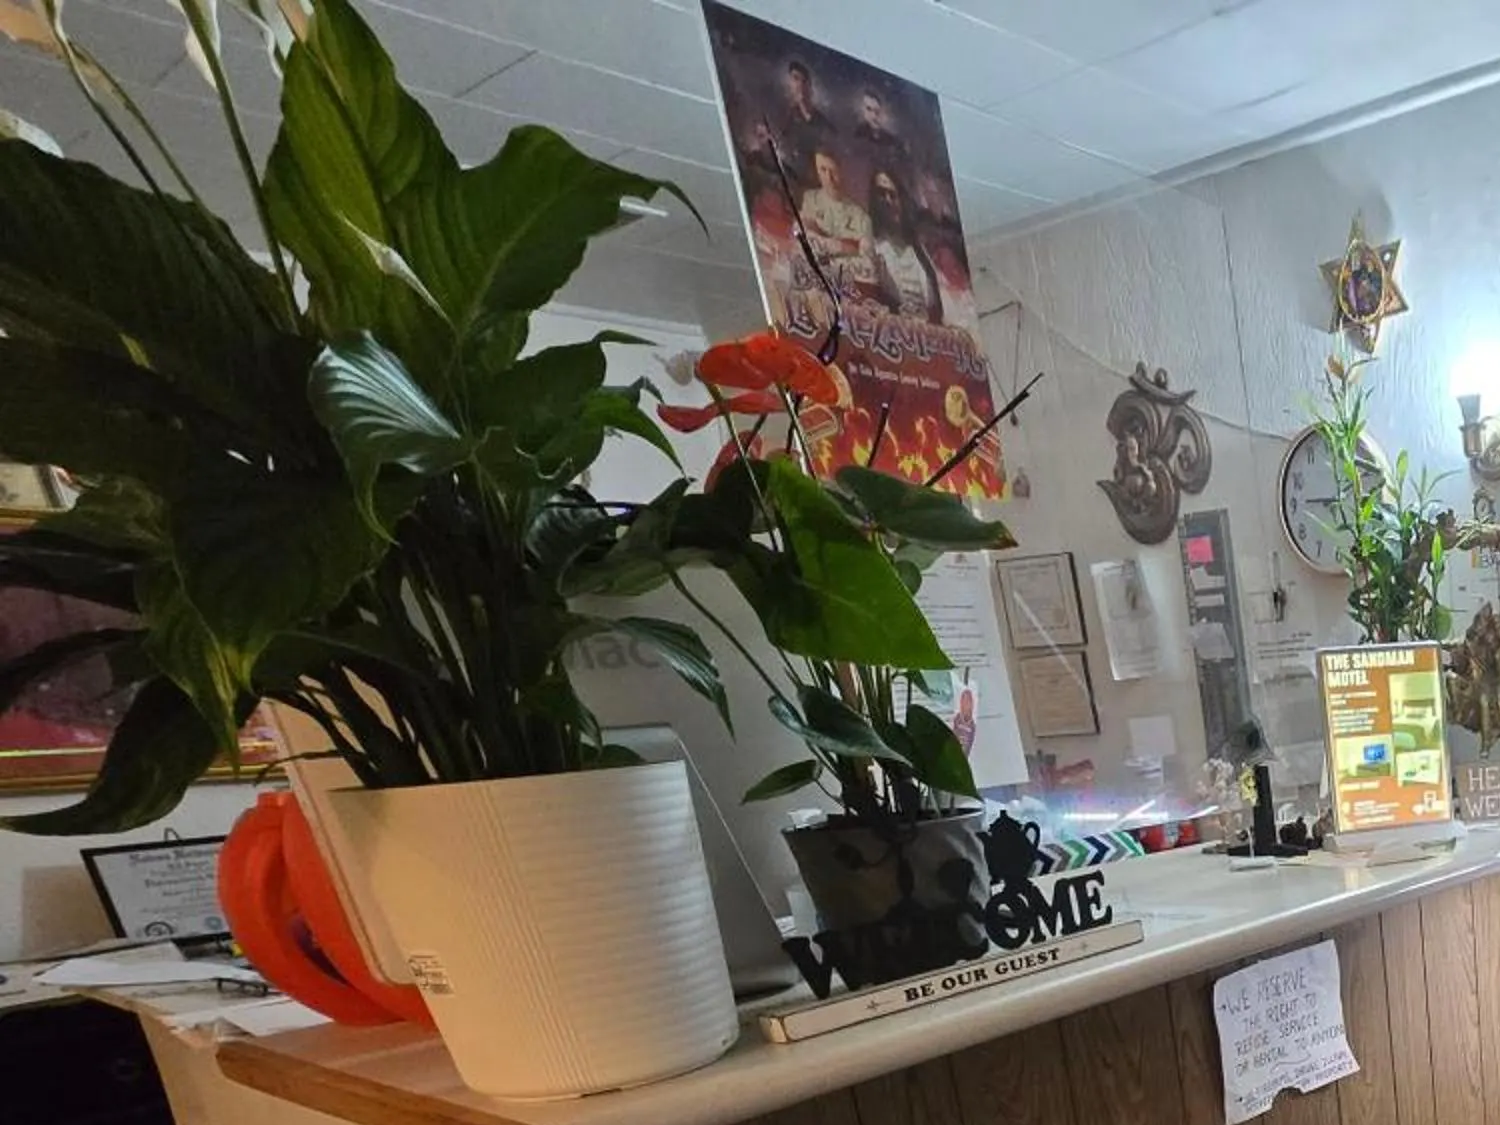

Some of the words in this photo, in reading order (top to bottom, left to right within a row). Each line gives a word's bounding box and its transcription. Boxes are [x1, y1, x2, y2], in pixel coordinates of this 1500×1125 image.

[1325, 653, 1350, 671] THE
[1351, 648, 1415, 670] SANDMAN
[1326, 669, 1371, 689] MOTEL
[780, 870, 1114, 1002] WCOME
[904, 981, 936, 1003] BE
[941, 967, 989, 991] OUR
[994, 947, 1061, 976] GUEST
